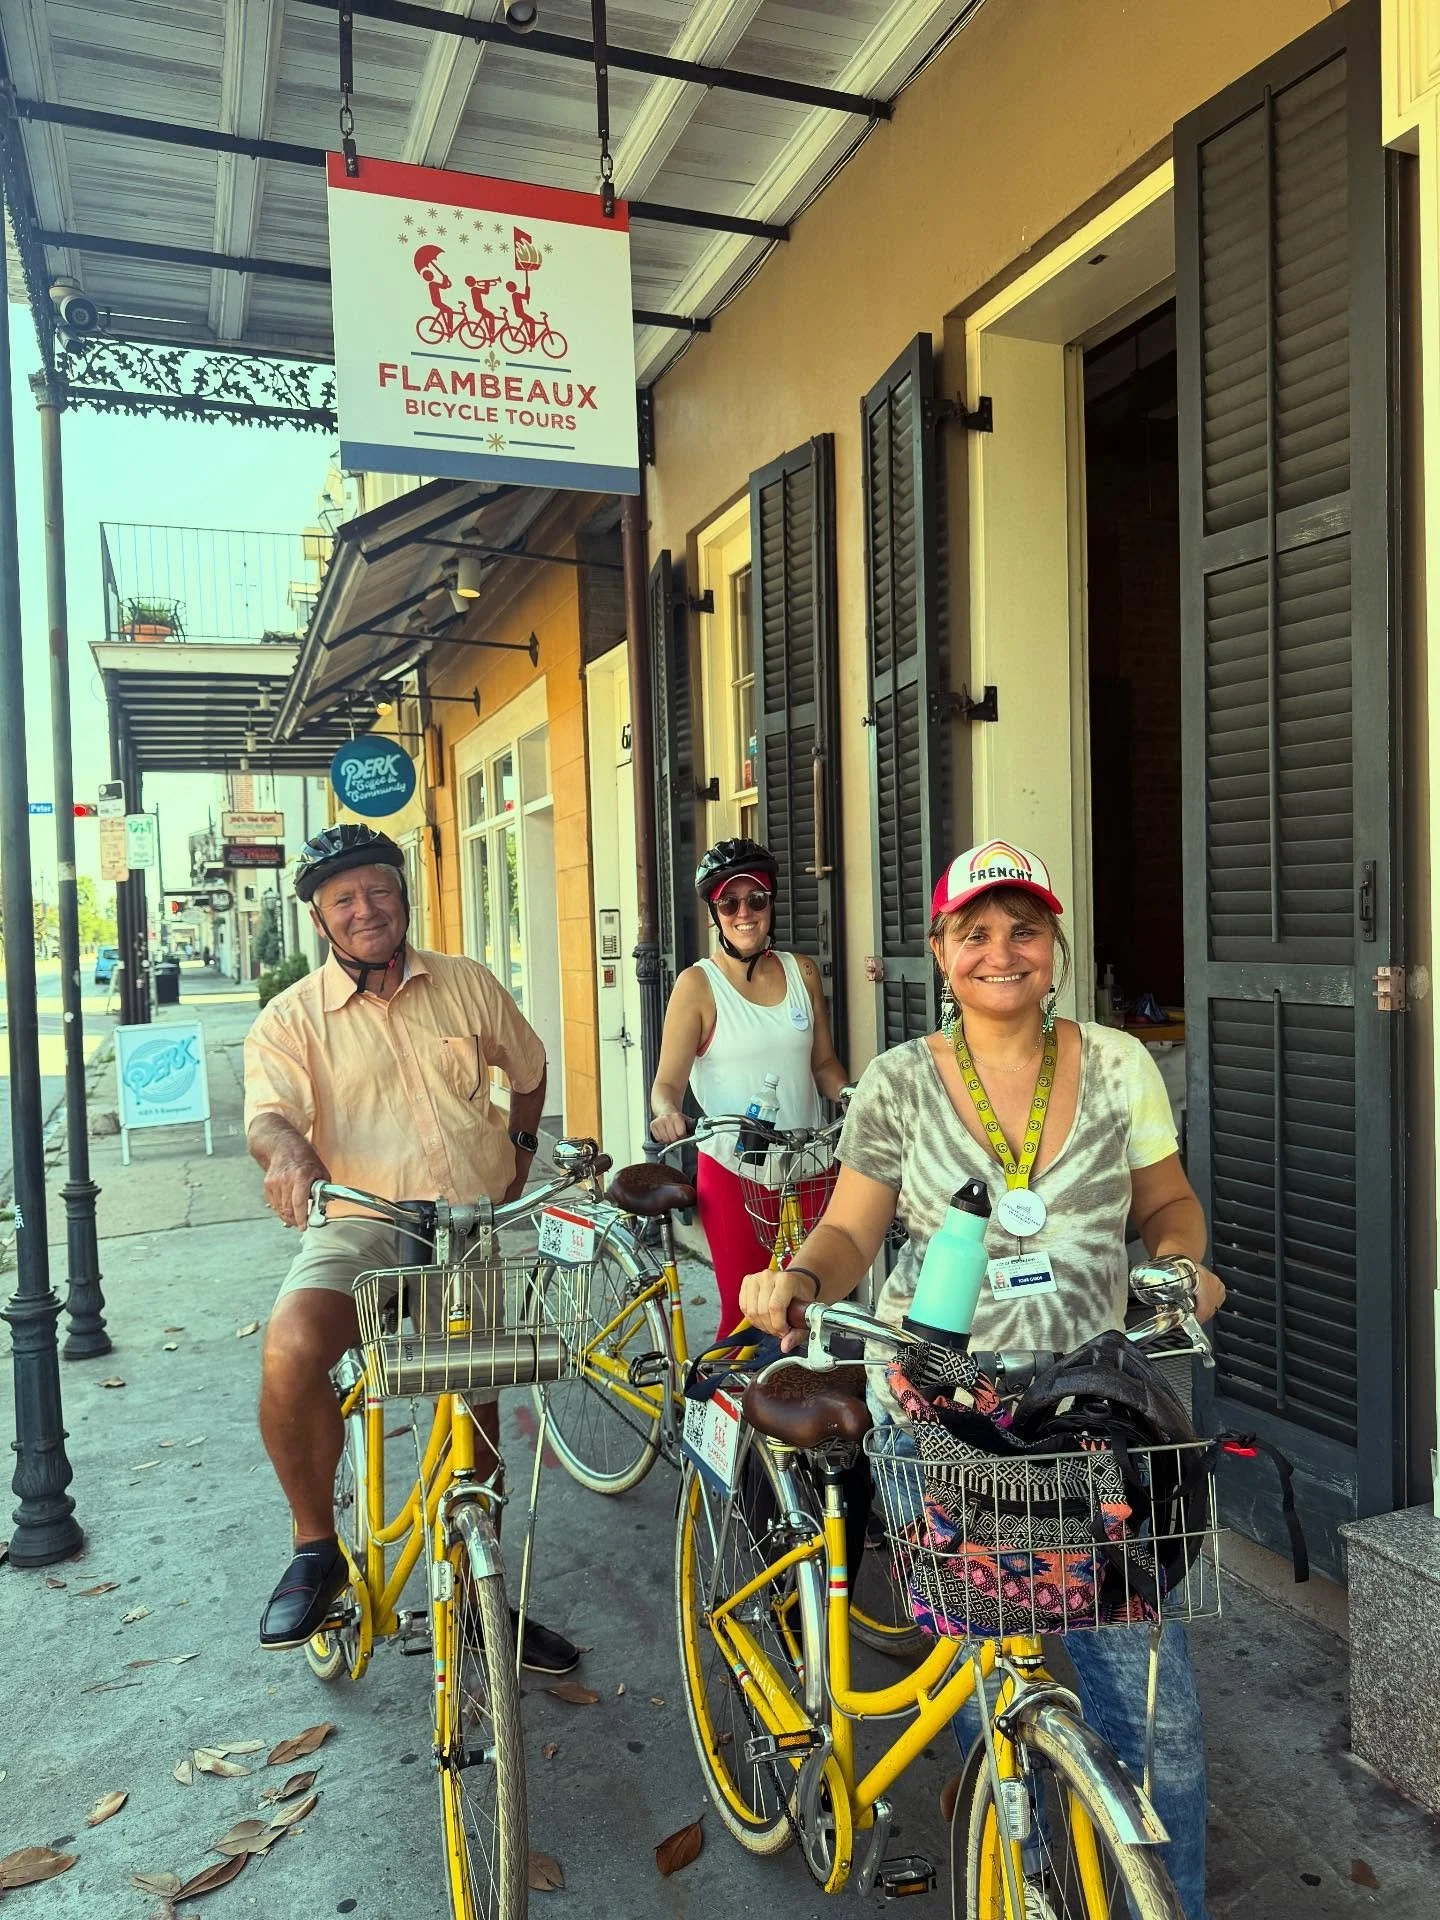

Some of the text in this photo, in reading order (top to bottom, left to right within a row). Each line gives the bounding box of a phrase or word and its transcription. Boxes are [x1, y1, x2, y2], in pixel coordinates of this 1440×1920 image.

[378, 362, 598, 410] FLAMBEAUX
[406, 398, 577, 431] BICYCLE TOURS
[340, 754, 401, 791] PERK
[346, 782, 406, 802] Community
[969, 867, 1033, 883] FRENCHY
[123, 1035, 200, 1106] PERK
[749, 1655, 776, 1702] PUBLIC
